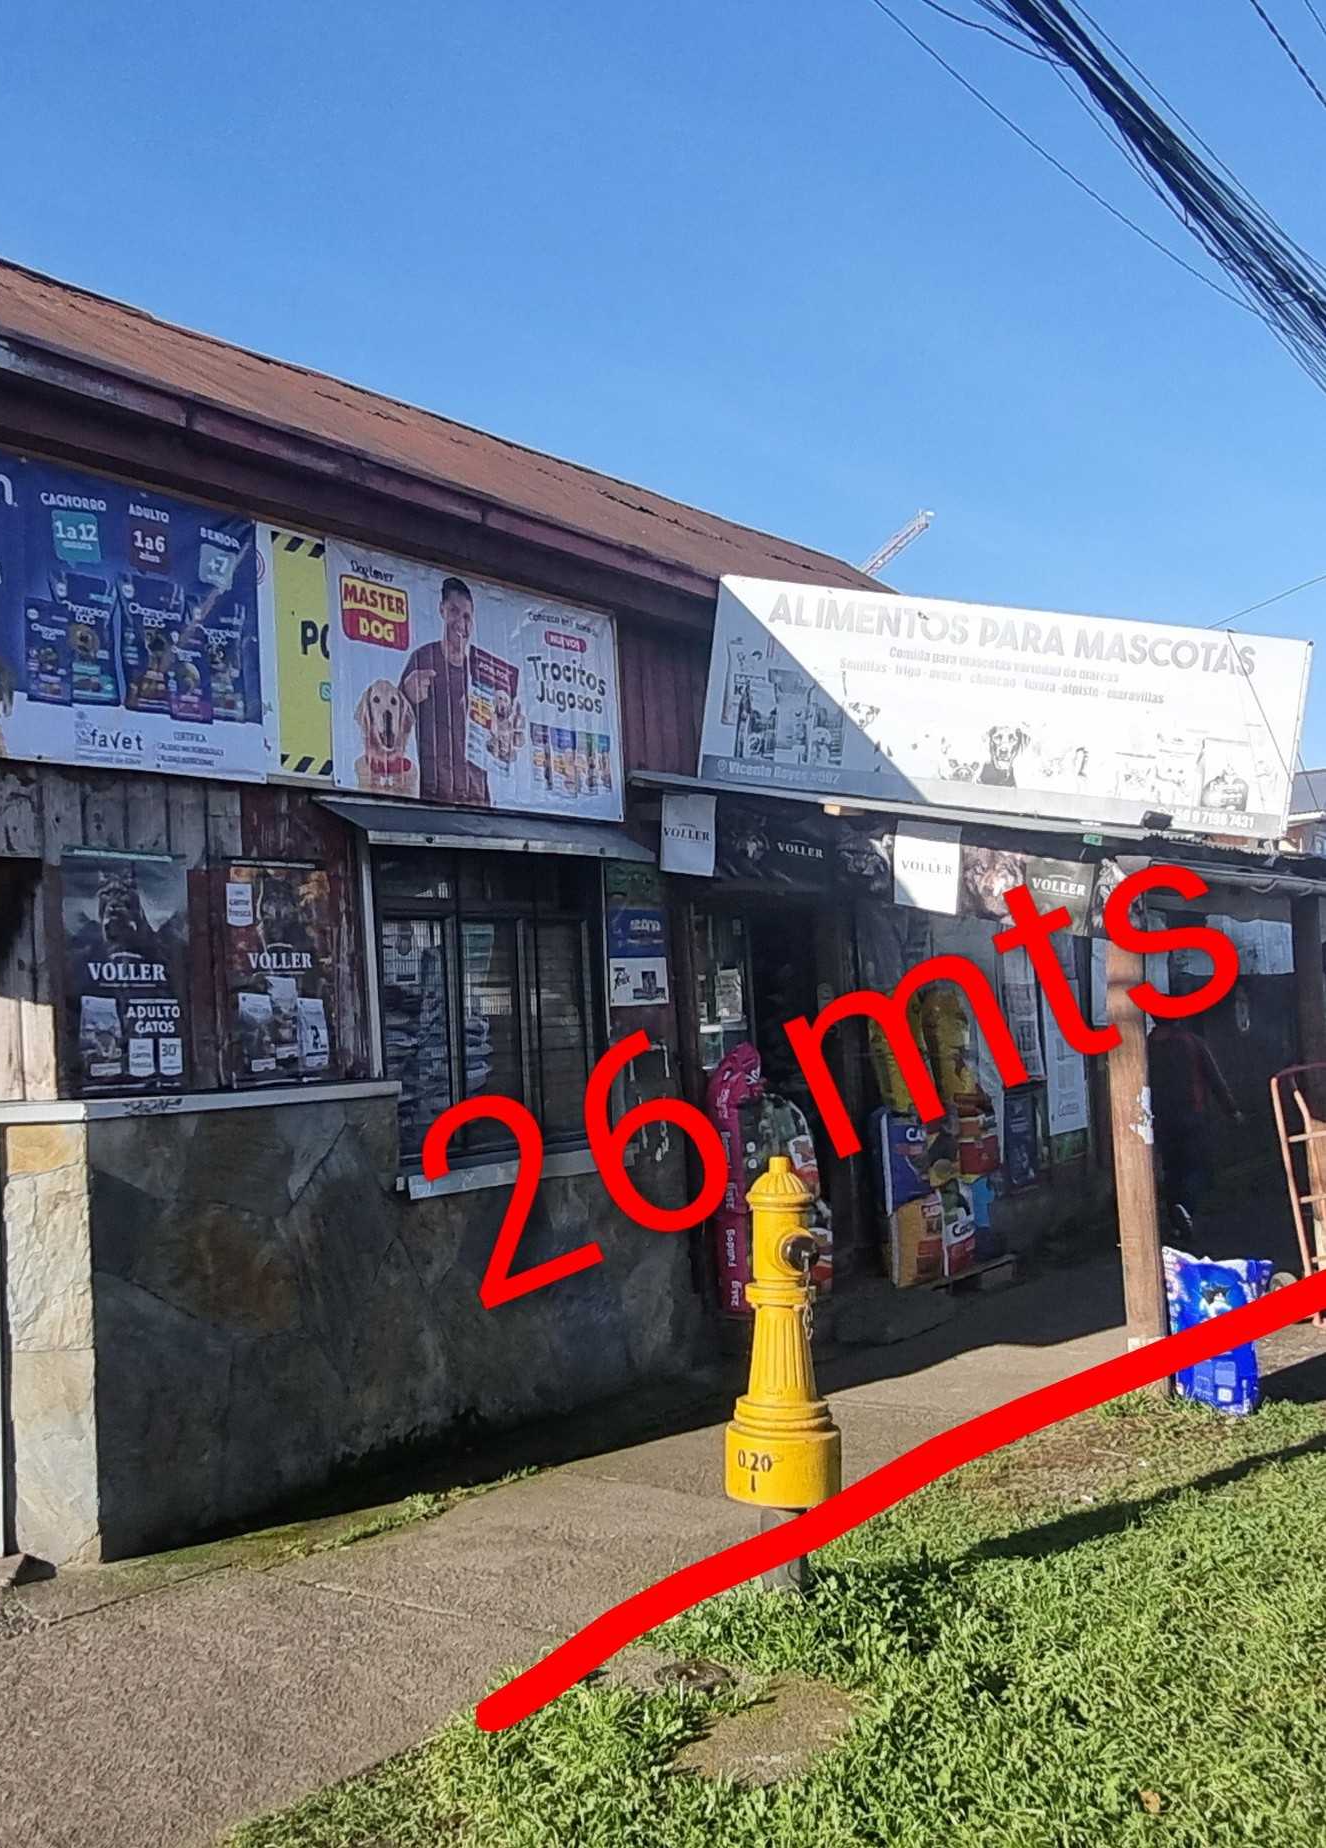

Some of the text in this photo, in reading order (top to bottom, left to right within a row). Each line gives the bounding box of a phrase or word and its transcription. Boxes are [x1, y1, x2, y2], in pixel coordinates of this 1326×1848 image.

[128, 503, 170, 523] ADULTO
[344, 583, 404, 615] MASTER
[359, 617, 394, 642] DOG
[768, 593, 1257, 677] ALIMENTOS PARA MASCOTAS
[527, 655, 606, 697] Trocitos
[536, 681, 602, 714] Jugosos
[663, 826, 710, 842] VOLLER
[777, 841, 823, 859] VOLLER
[901, 859, 952, 876] VOLLER
[1032, 877, 1086, 896] VOLLER
[248, 952, 312, 969] VOLLER
[88, 962, 167, 982] VOLLER
[126, 1005, 181, 1018] ADULTO
[135, 1021, 175, 1033] GATOS
